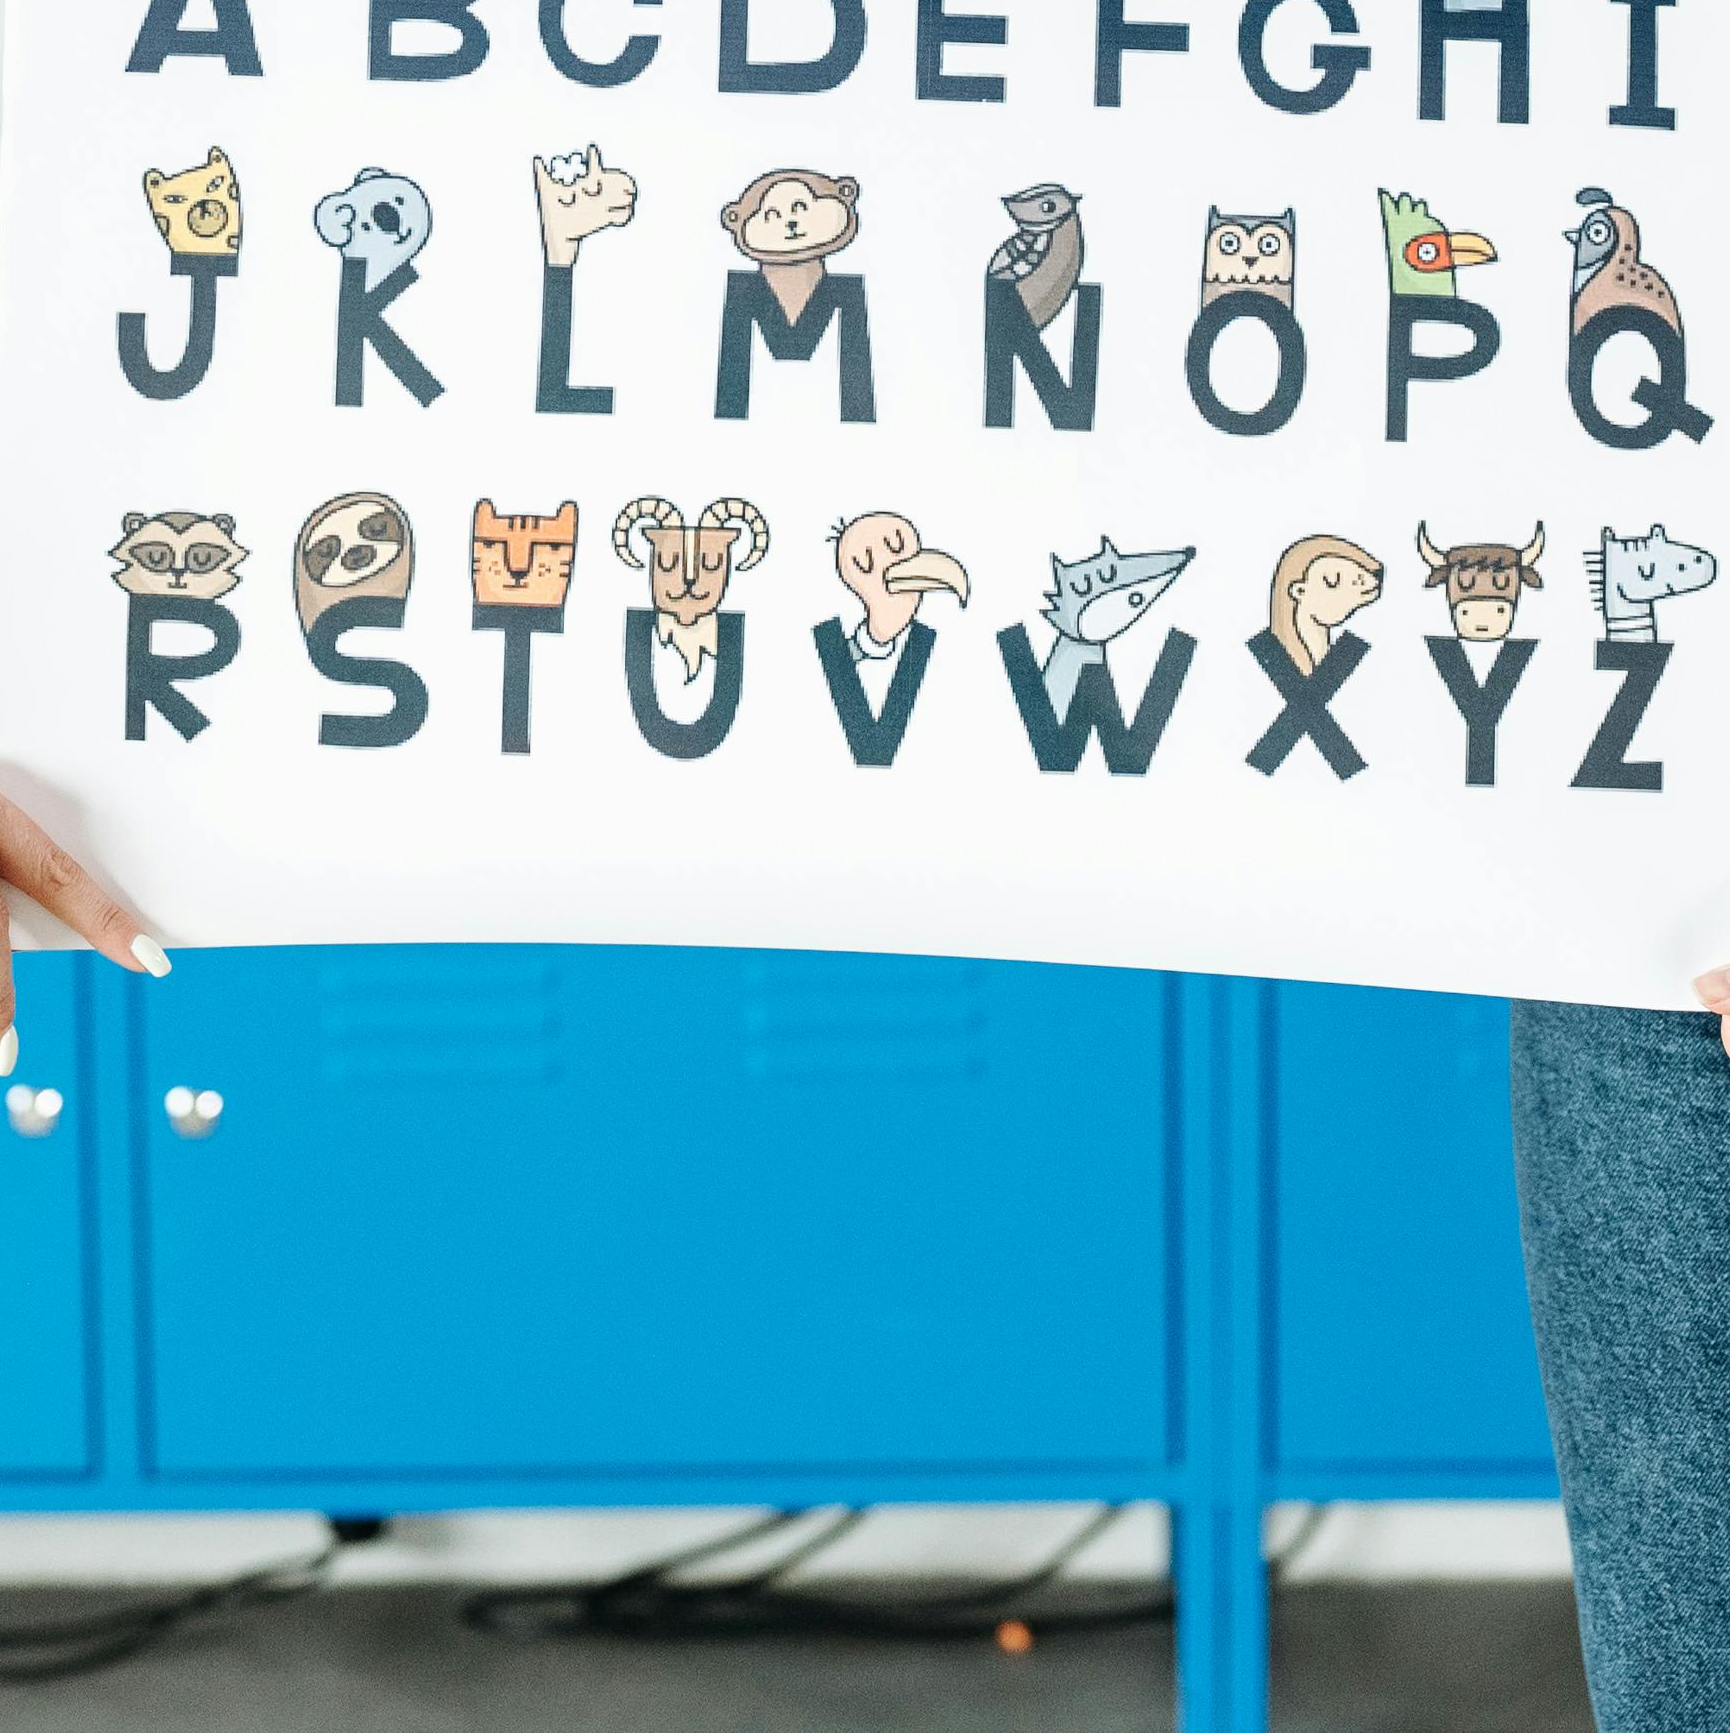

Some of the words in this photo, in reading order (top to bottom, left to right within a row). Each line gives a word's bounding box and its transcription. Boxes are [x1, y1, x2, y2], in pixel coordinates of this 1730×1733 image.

[116, 251, 238, 400] J
[334, 259, 445, 408] K
[535, 263, 614, 415] L
[713, 270, 876, 423] M
[983, 277, 1102, 432] N
[1185, 289, 1307, 437] O
[1385, 293, 1501, 442] P
[1566, 304, 1712, 451] Q
[124, 592, 240, 744] R
[306, 594, 430, 749] S
[474, 603, 563, 755] T
[624, 607, 745, 760] U
[814, 617, 936, 767] V
[994, 627, 1195, 777] W
[1245, 632, 1371, 781] X
[1425, 637, 1539, 788] Y
[1571, 639, 1673, 793] Z
